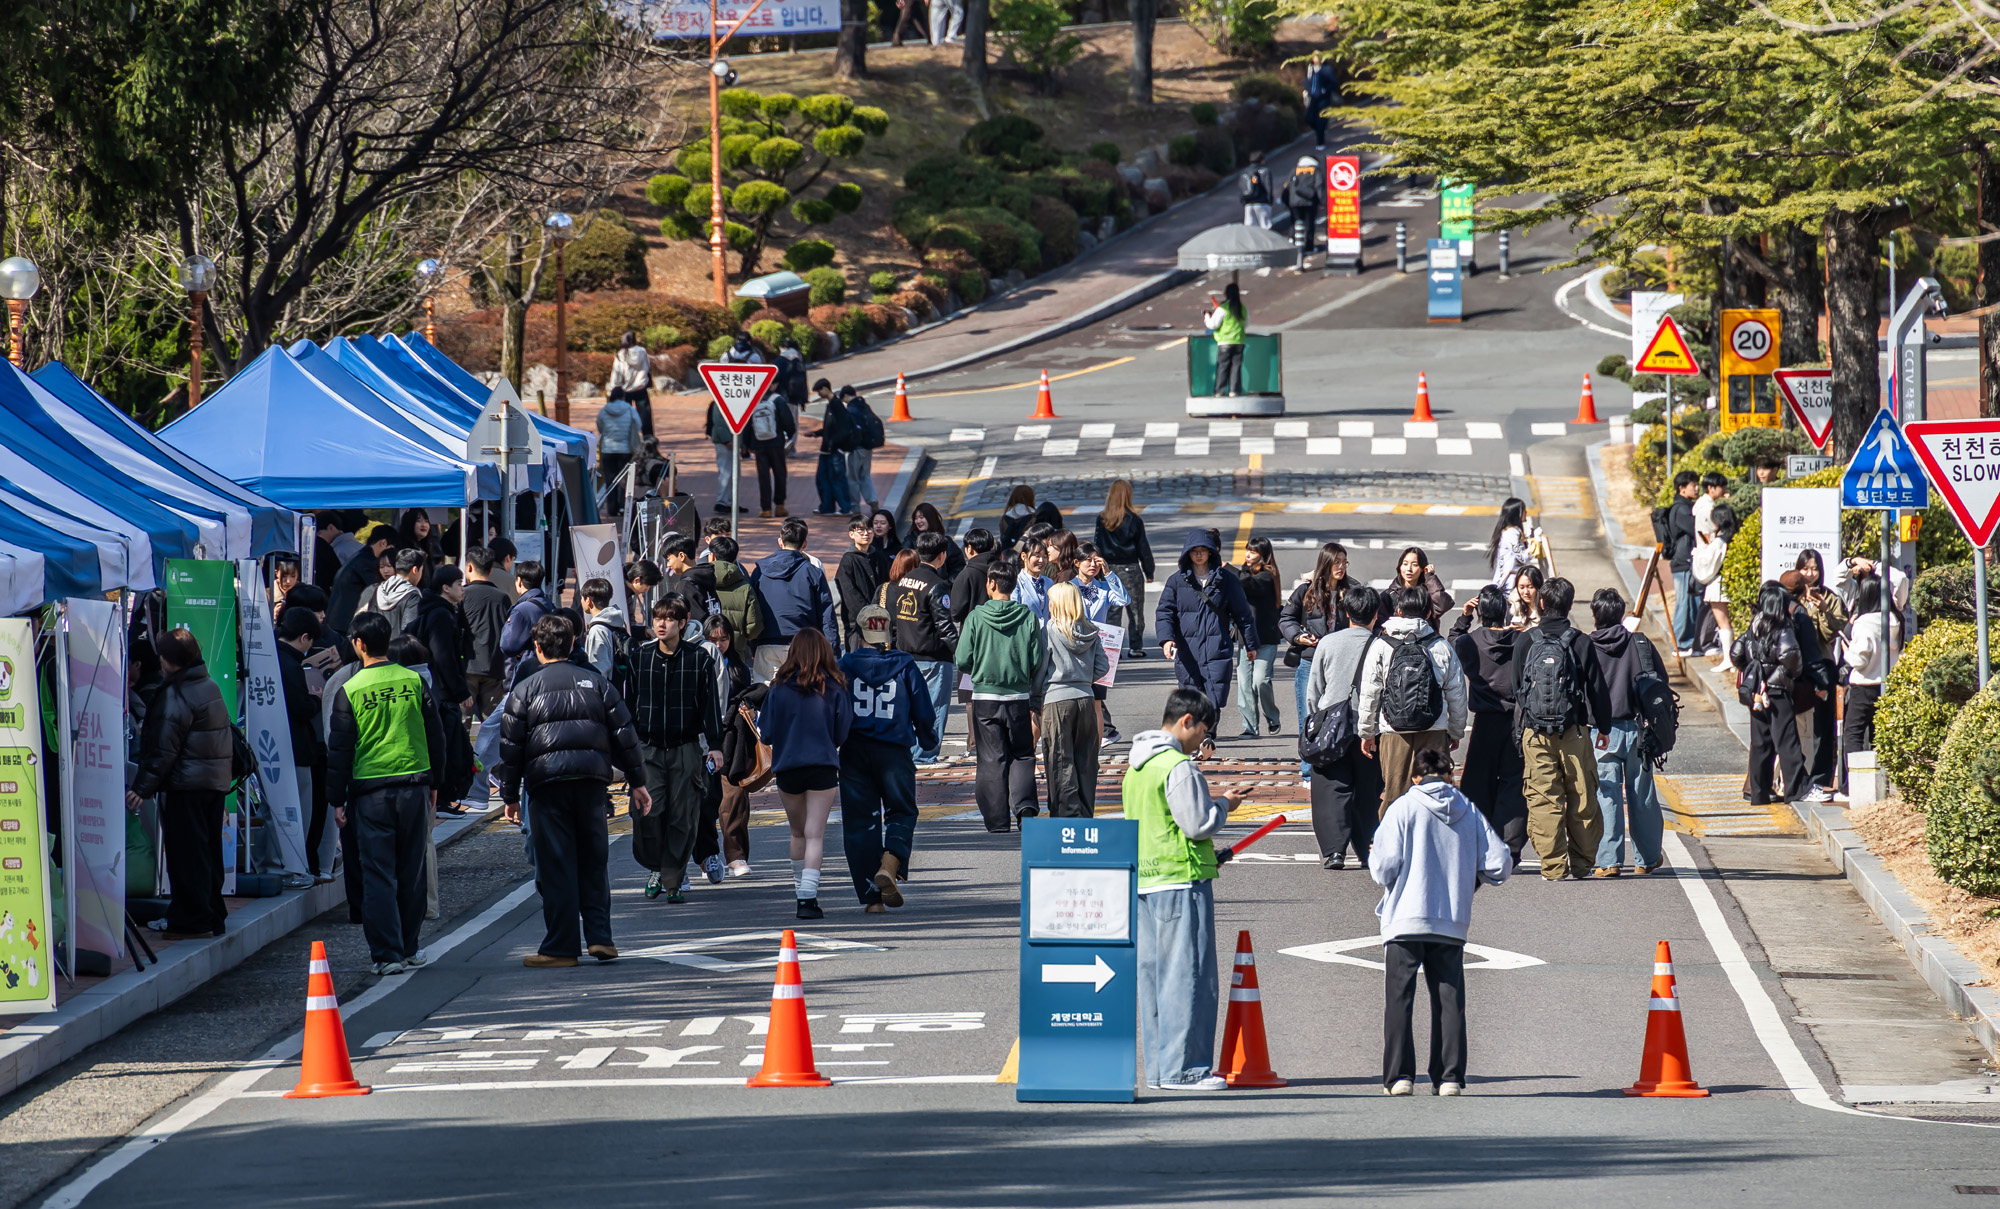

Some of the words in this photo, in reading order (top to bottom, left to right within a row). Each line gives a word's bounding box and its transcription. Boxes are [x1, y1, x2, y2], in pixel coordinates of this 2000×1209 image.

[781, 8, 828, 27] 입니다.
[1738, 330, 1766, 350] 20
[1904, 349, 1915, 384] CCTV
[719, 373, 756, 387] 천천히
[724, 388, 751, 398] SLOW
[1856, 490, 1914, 504] 횡단보도
[868, 617, 888, 631] NY
[361, 684, 417, 710] 상록수
[853, 677, 897, 720] 92
[1051, 1012, 1103, 1022] 계명대학교
